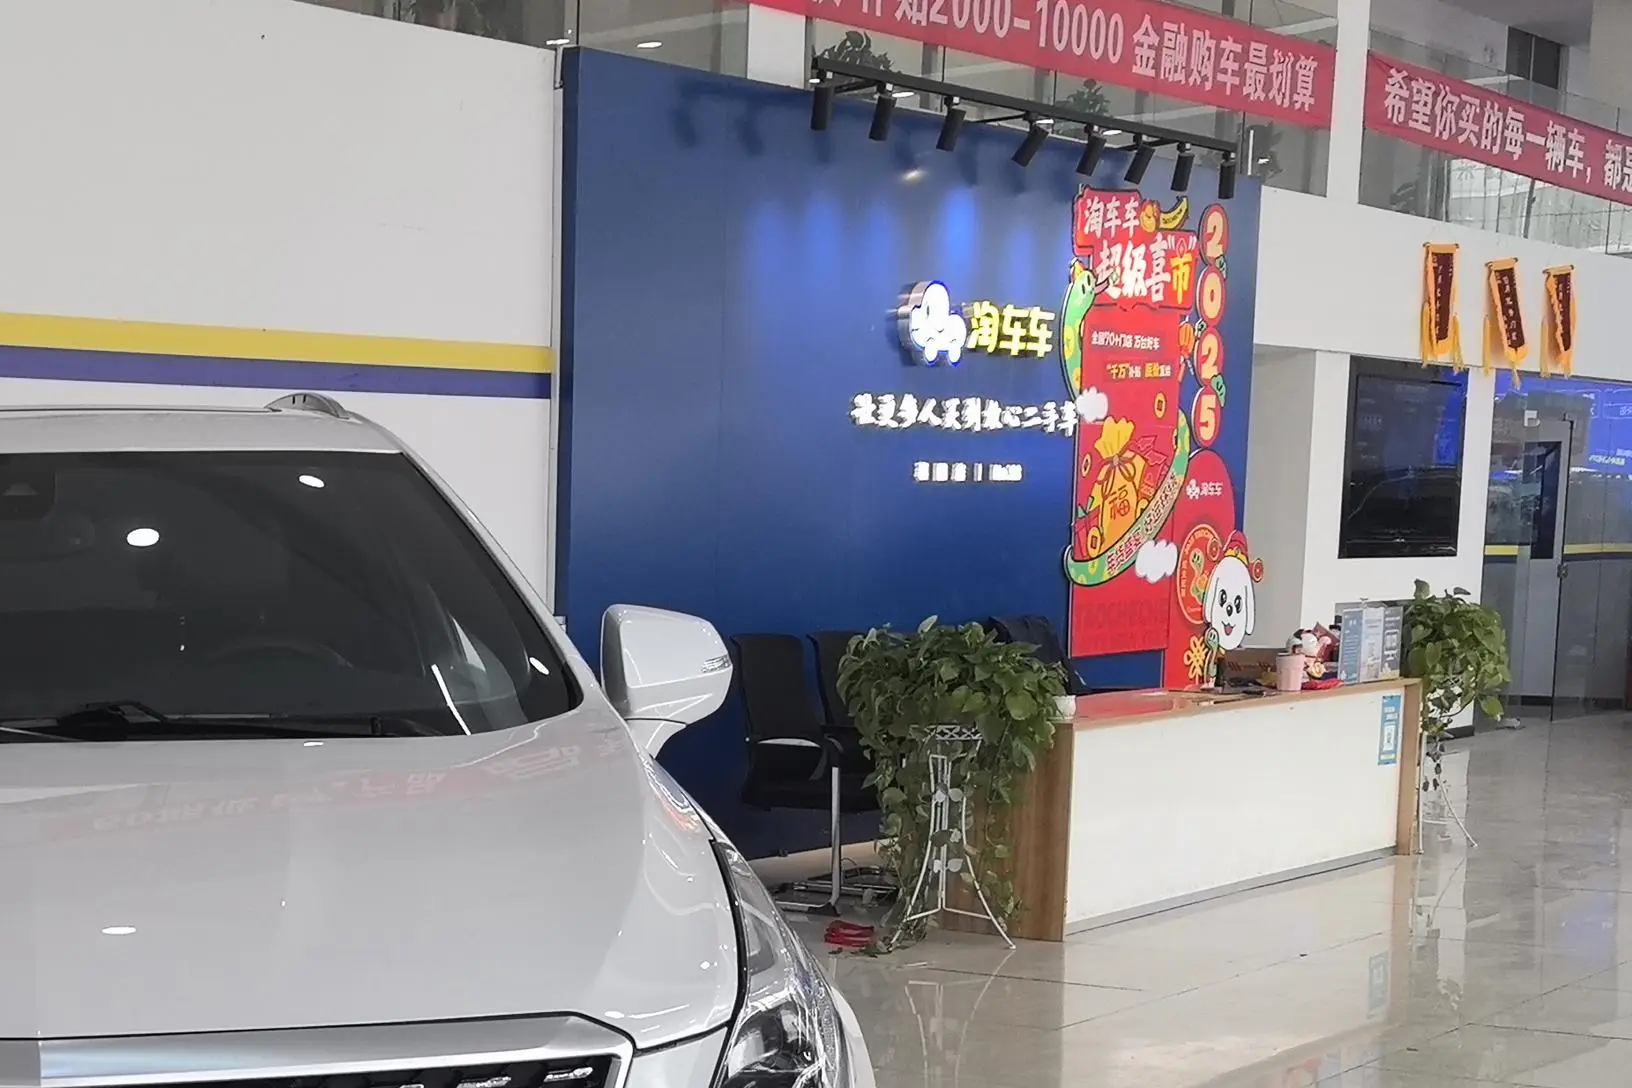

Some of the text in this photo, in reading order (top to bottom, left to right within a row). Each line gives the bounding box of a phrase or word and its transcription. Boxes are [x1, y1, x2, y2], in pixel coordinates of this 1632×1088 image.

[1131, 14, 1319, 112] 金融购车最划算
[1084, 196, 1139, 239] 淘车车
[968, 301, 1056, 358] 淘车车
